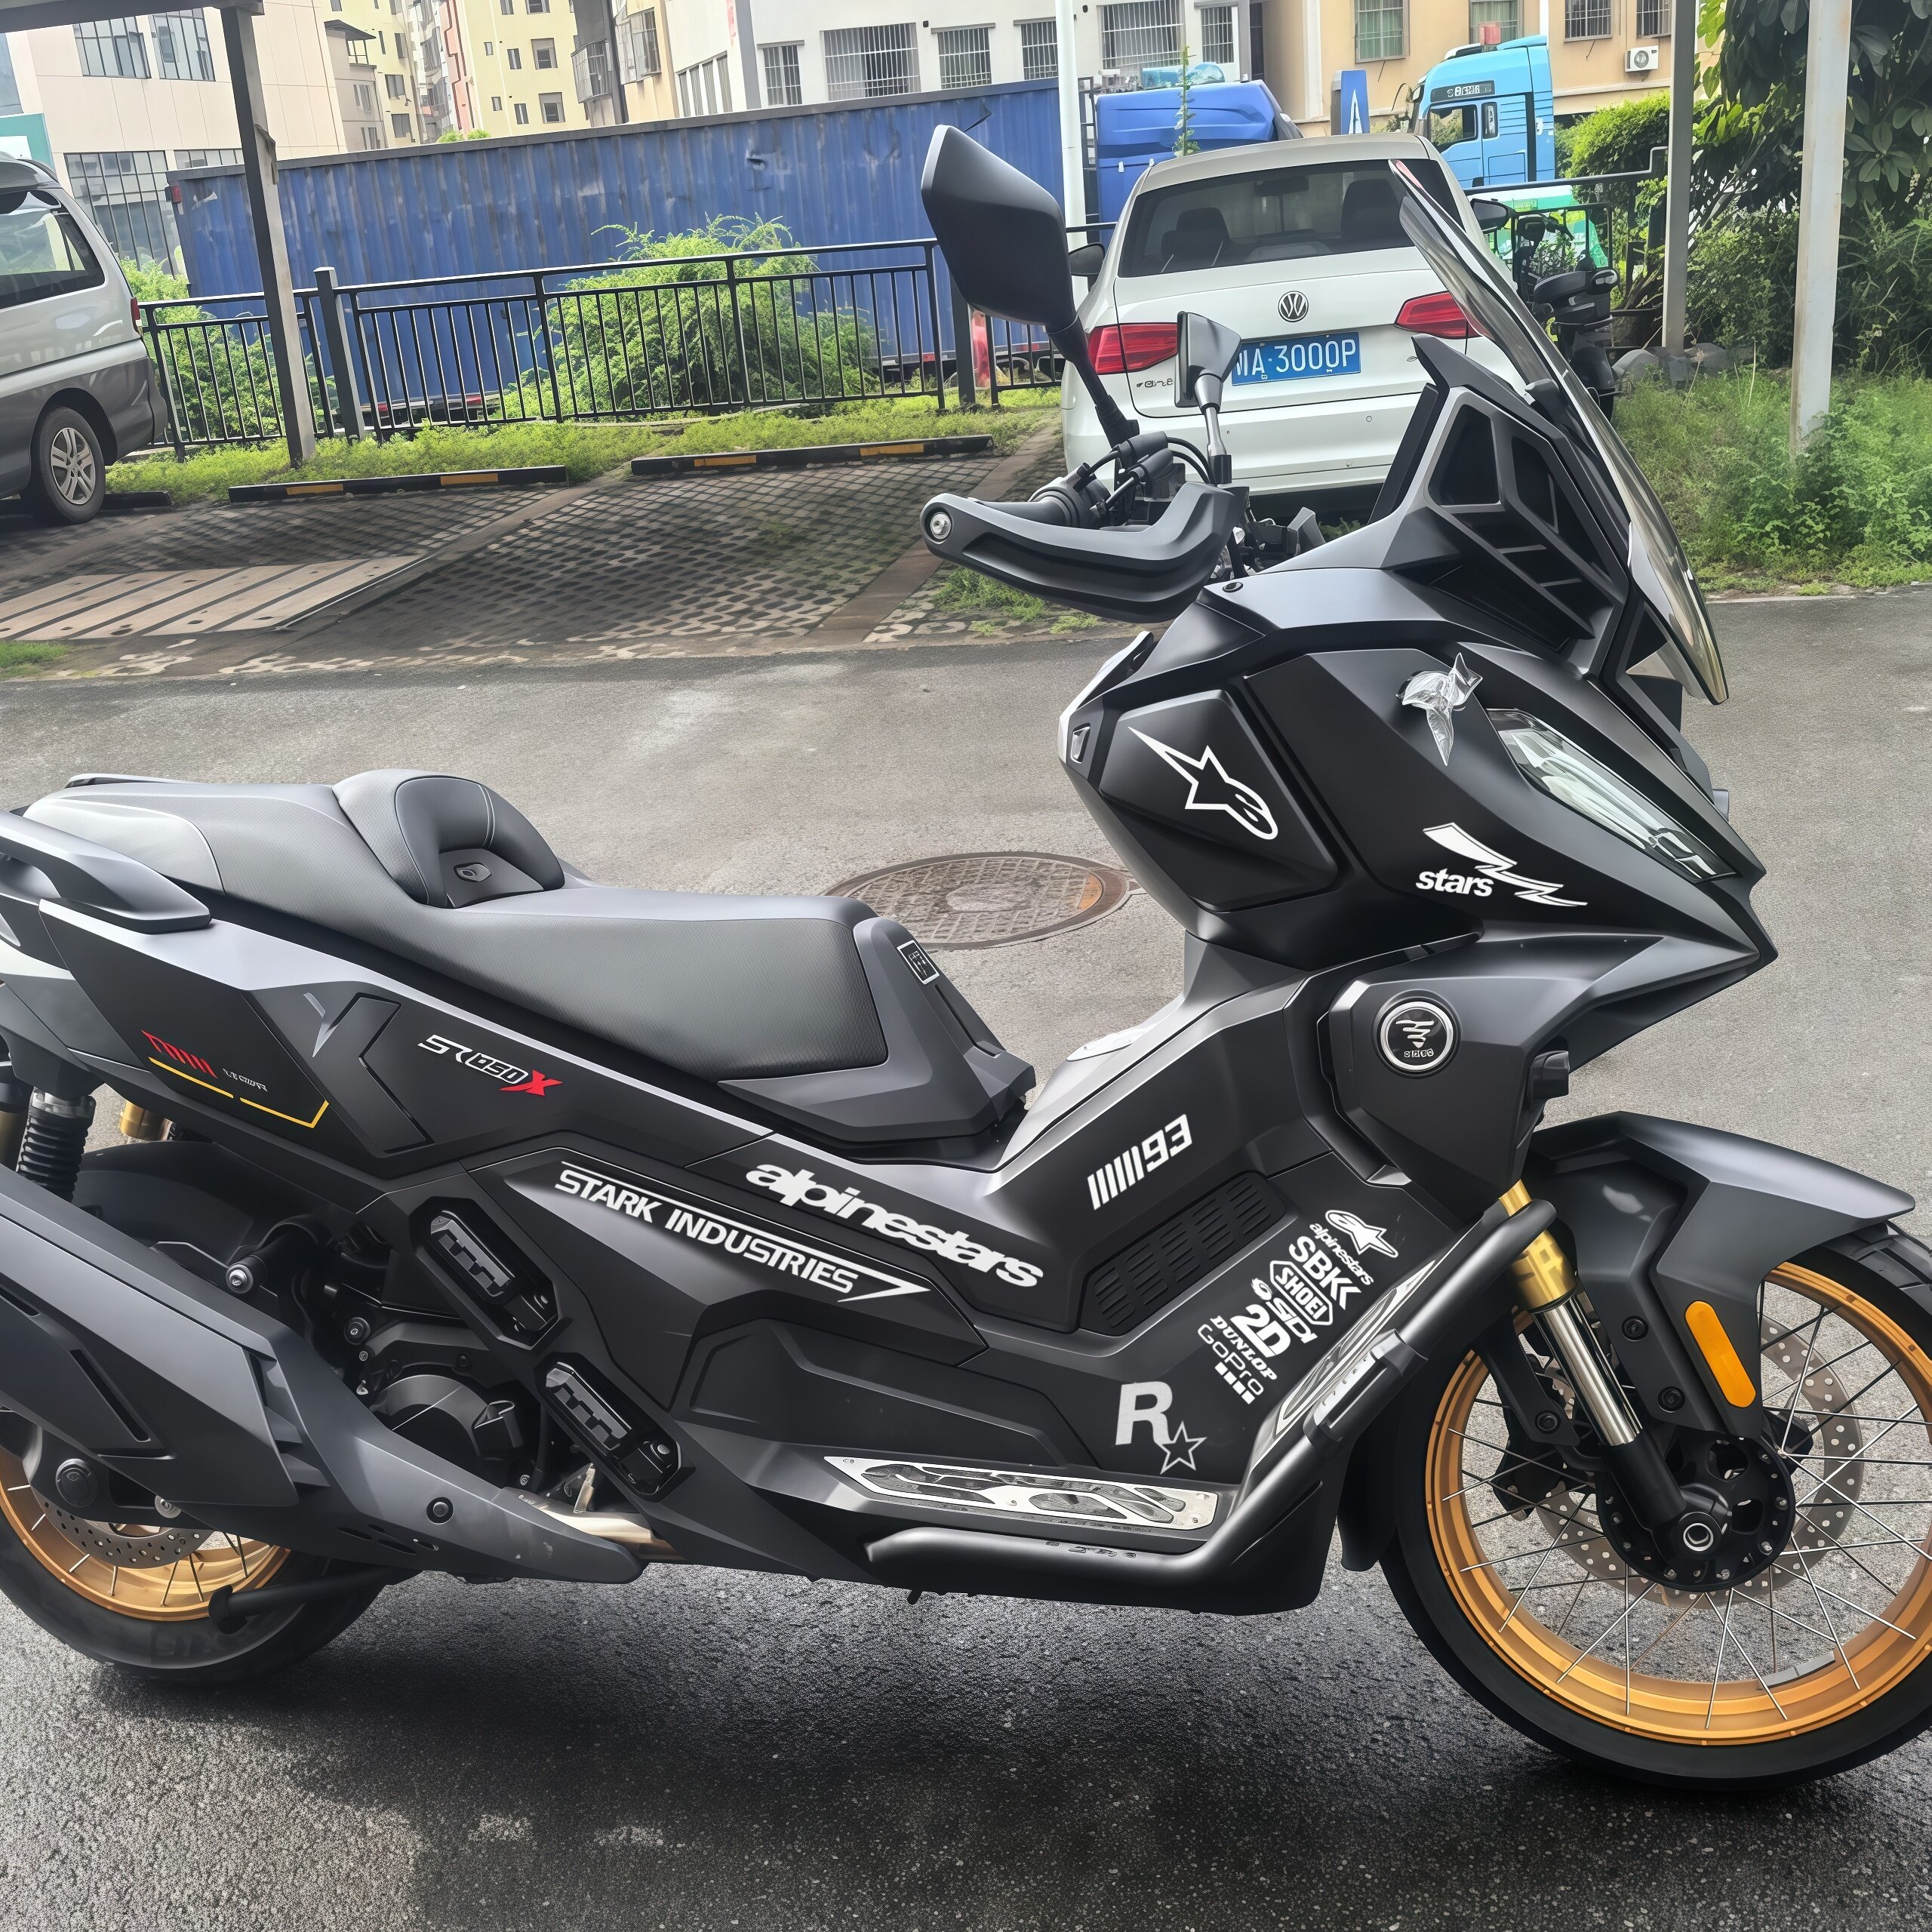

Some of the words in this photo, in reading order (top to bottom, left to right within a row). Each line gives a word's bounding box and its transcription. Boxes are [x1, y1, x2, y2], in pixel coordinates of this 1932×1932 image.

[1416, 868, 1494, 897] stars
[555, 1169, 663, 1223] STARK
[665, 1208, 859, 1294] INDUSTRIES
[746, 1163, 1044, 1287] alpinestars
[1309, 1223, 1374, 1285] alpinestars
[1275, 1266, 1327, 1320] SHOEI
[1197, 1324, 1264, 1395] GoPro
[1210, 1315, 1278, 1380] DUNLOP
